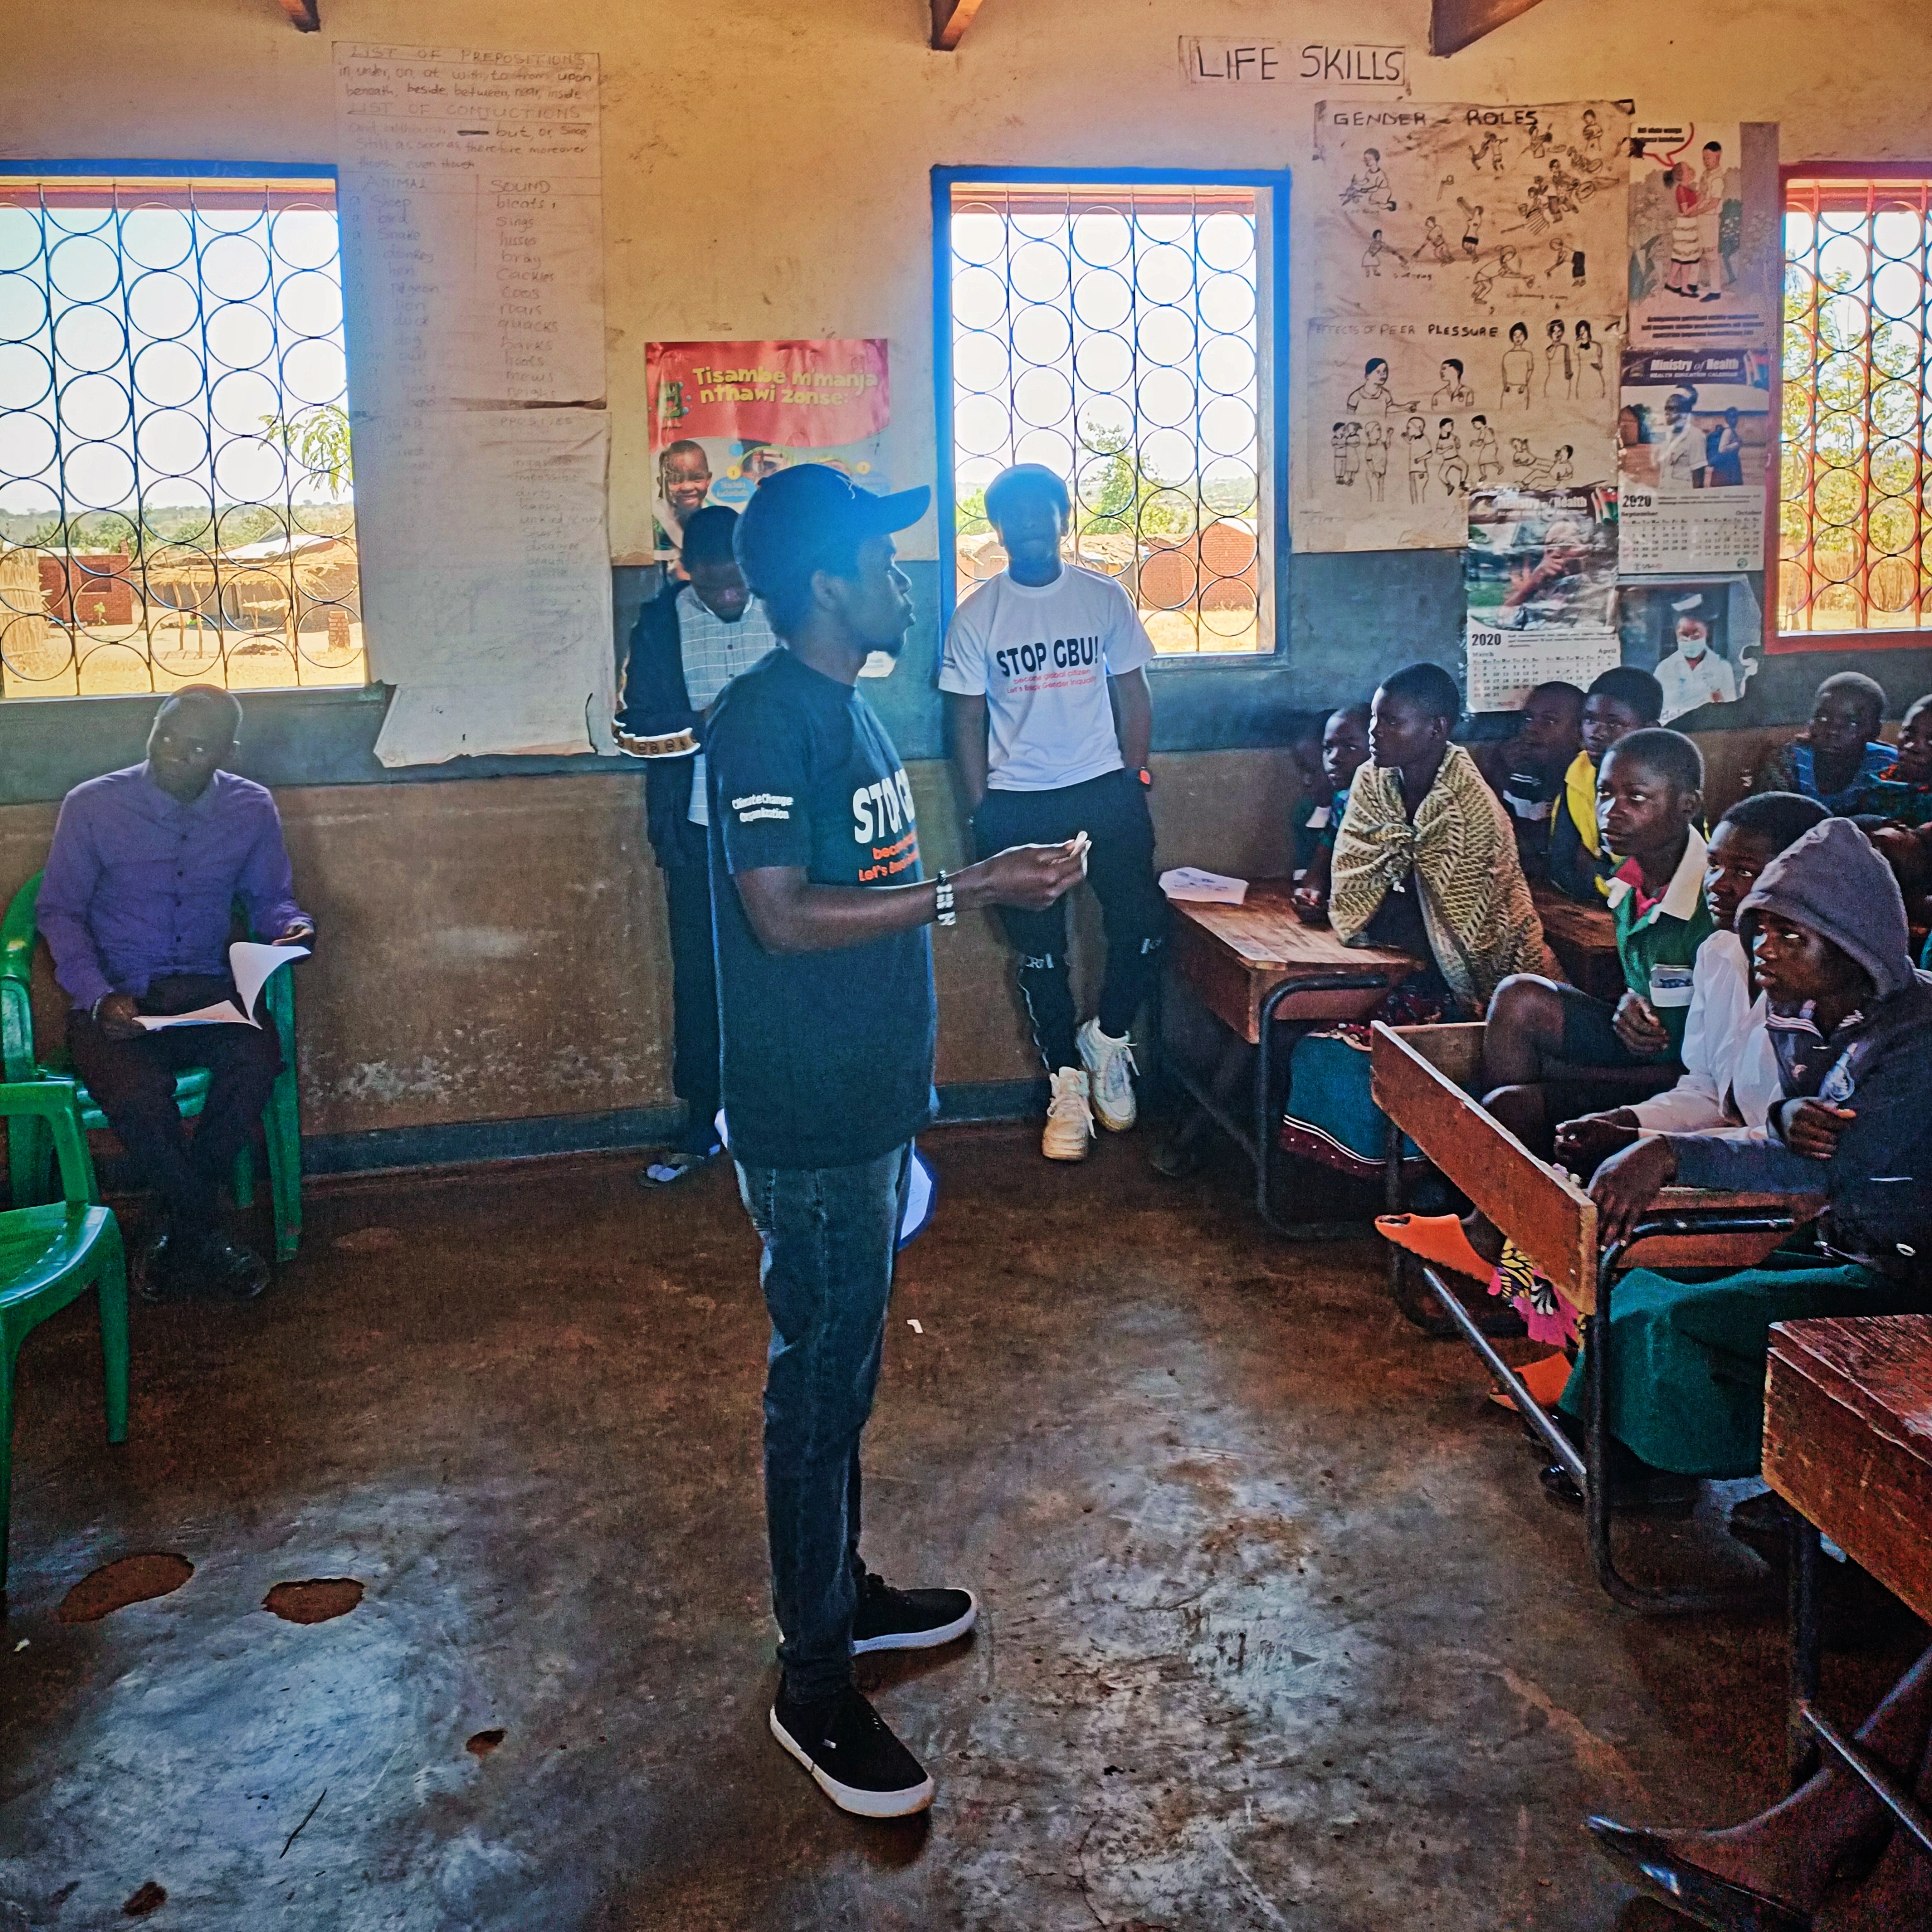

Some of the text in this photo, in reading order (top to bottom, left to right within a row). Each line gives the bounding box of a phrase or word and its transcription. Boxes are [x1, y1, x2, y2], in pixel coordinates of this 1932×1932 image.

[350, 45, 586, 66] LIST OF PREPOSITIONS
[1197, 45, 1404, 80] LIFE SKILLS
[558, 72, 592, 84] upon
[1334, 109, 1538, 126] GENDER ROLES
[488, 179, 551, 194] SOUND
[1316, 323, 1499, 338] EFFECTS OF PEER PLESSURE
[1650, 358, 1740, 372] Ministry of Health
[692, 366, 879, 396] Tisambe m'manja
[699, 384, 849, 406] nthawi zonse:
[1472, 633, 1502, 646] 2020
[996, 635, 1098, 677] STOP GBU!
[852, 777, 903, 844] STOP
[858, 865, 888, 882] Let's
